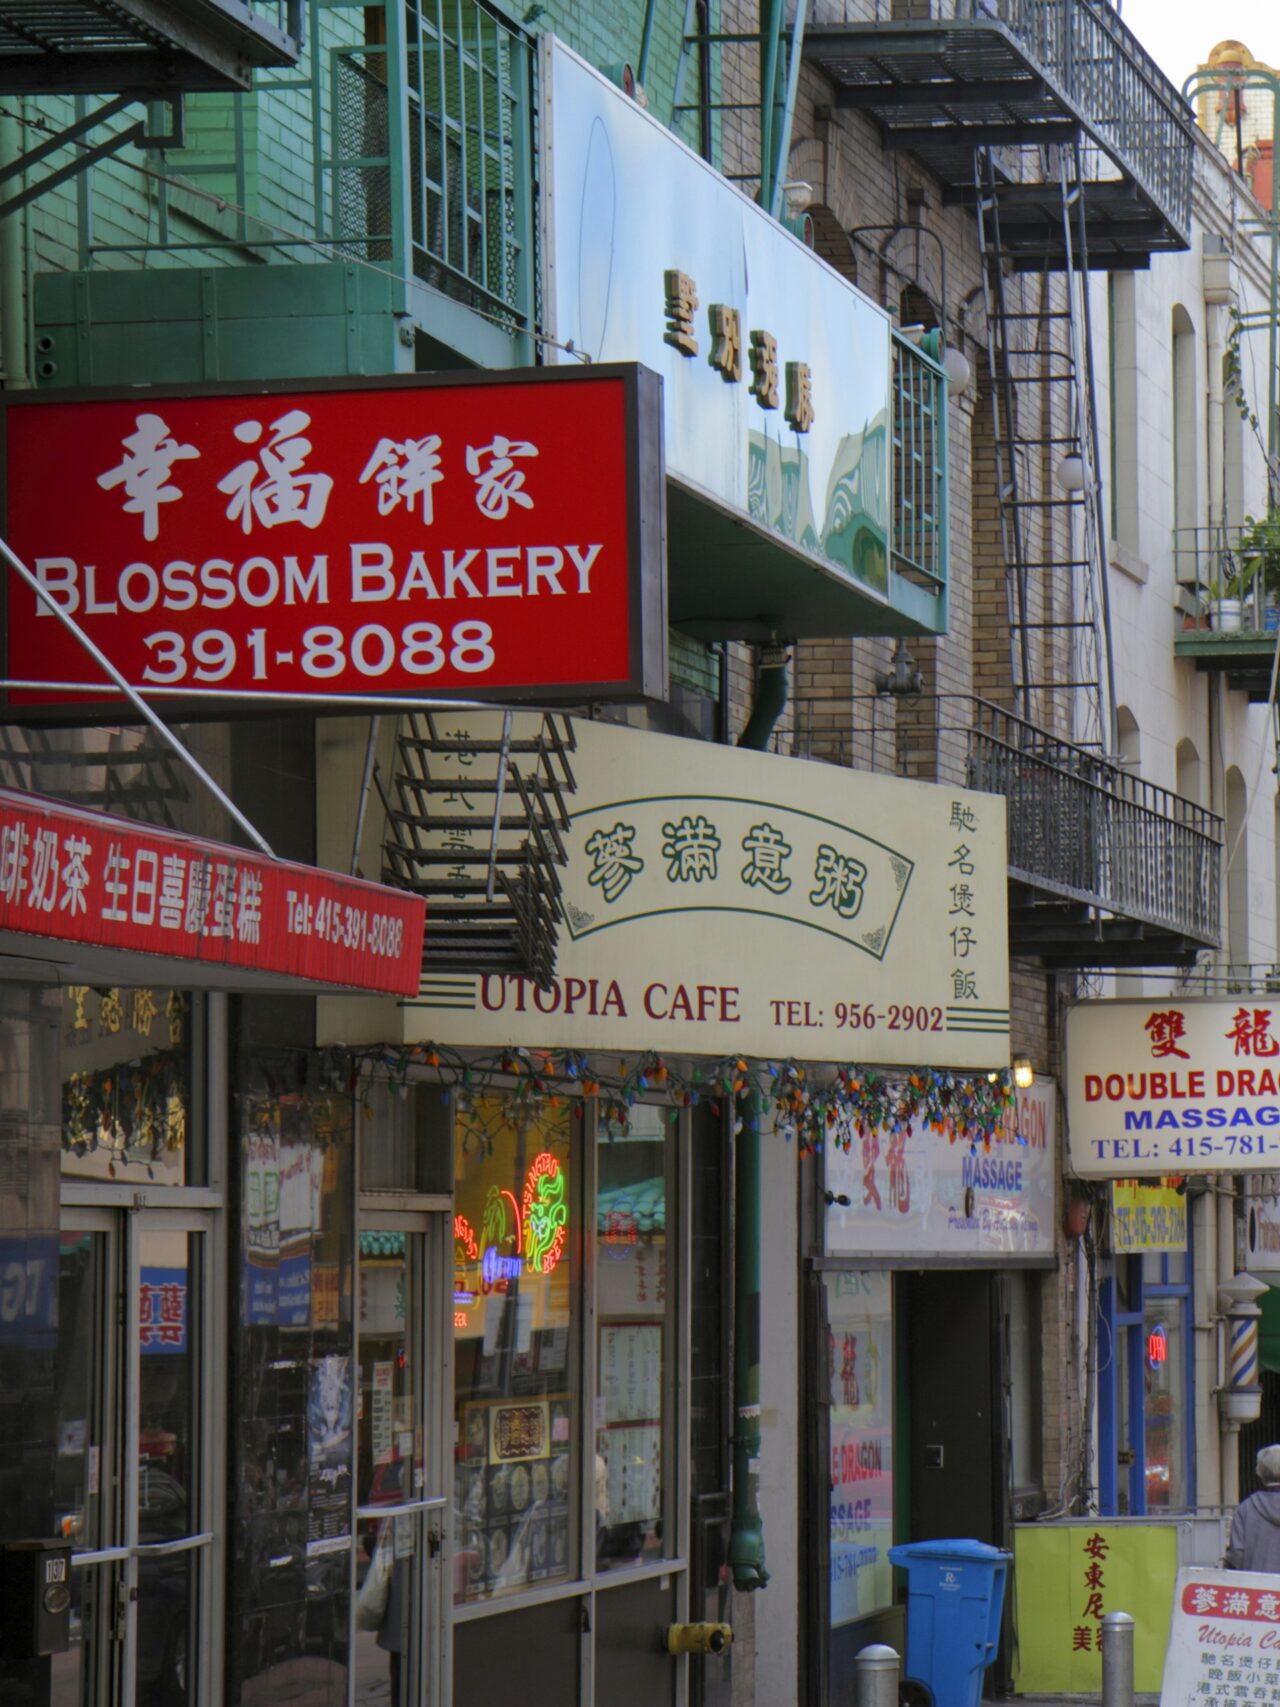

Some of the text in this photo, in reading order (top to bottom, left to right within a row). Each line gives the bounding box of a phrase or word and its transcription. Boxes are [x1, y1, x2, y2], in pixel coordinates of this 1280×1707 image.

[97, 409, 539, 541] 幸福餅家
[349, 543, 604, 603] BAKERY
[142, 619, 496, 684] 391-8088
[101, 842, 263, 945] 生日喜慶蛋糕
[948, 800, 980, 1001] 馳名煲仔飯
[287, 889, 404, 959] Tel: 415-391-8088
[480, 973, 741, 1024] UTOPIA CAFE
[770, 1000, 944, 1032] TEL: 956-2902
[1143, 1006, 1280, 1059] 雙龍
[1084, 1070, 1205, 1102] DOUBLE
[962, 1155, 1023, 1191] MASSAGE
[1091, 1138, 1160, 1160] TEL:
[543, 1225, 566, 1274] BEER
[1149, 1334, 1167, 1361] OPEN
[840, 1439, 882, 1484] DRAGON
[1198, 1624, 1252, 1651] Utopia
[1207, 1667, 1280, 1686] 晚飯小菜
